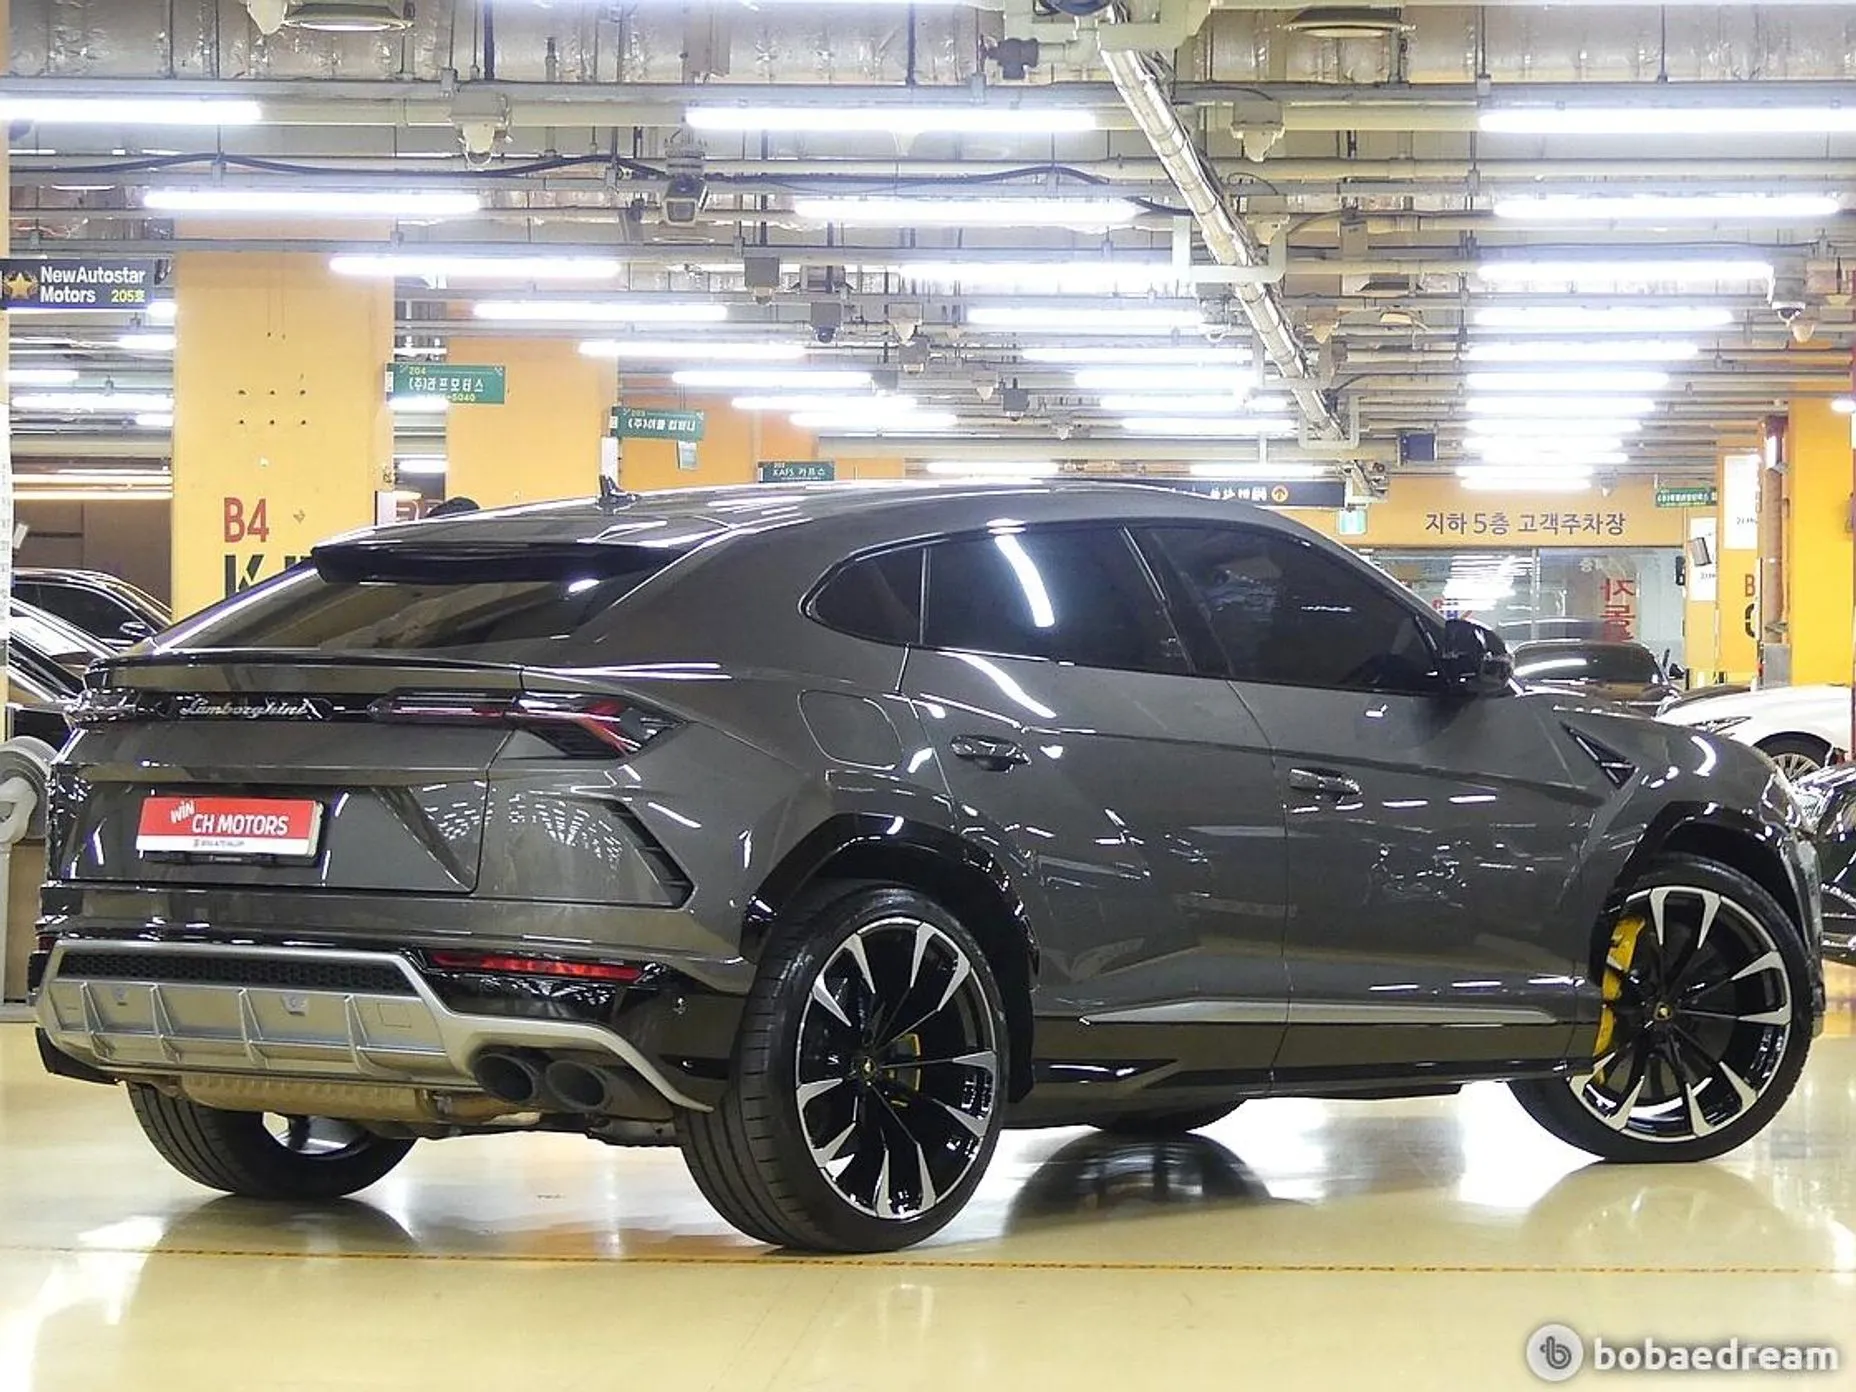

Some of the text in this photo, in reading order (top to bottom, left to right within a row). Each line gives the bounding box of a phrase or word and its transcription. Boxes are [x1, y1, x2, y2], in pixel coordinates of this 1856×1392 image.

[40, 285, 96, 303] Motors
[409, 366, 426, 376] 204
[223, 496, 270, 543] B4
[1425, 511, 1626, 536] 지하 5층 고객주차장
[191, 813, 290, 836] CH MOTORS
